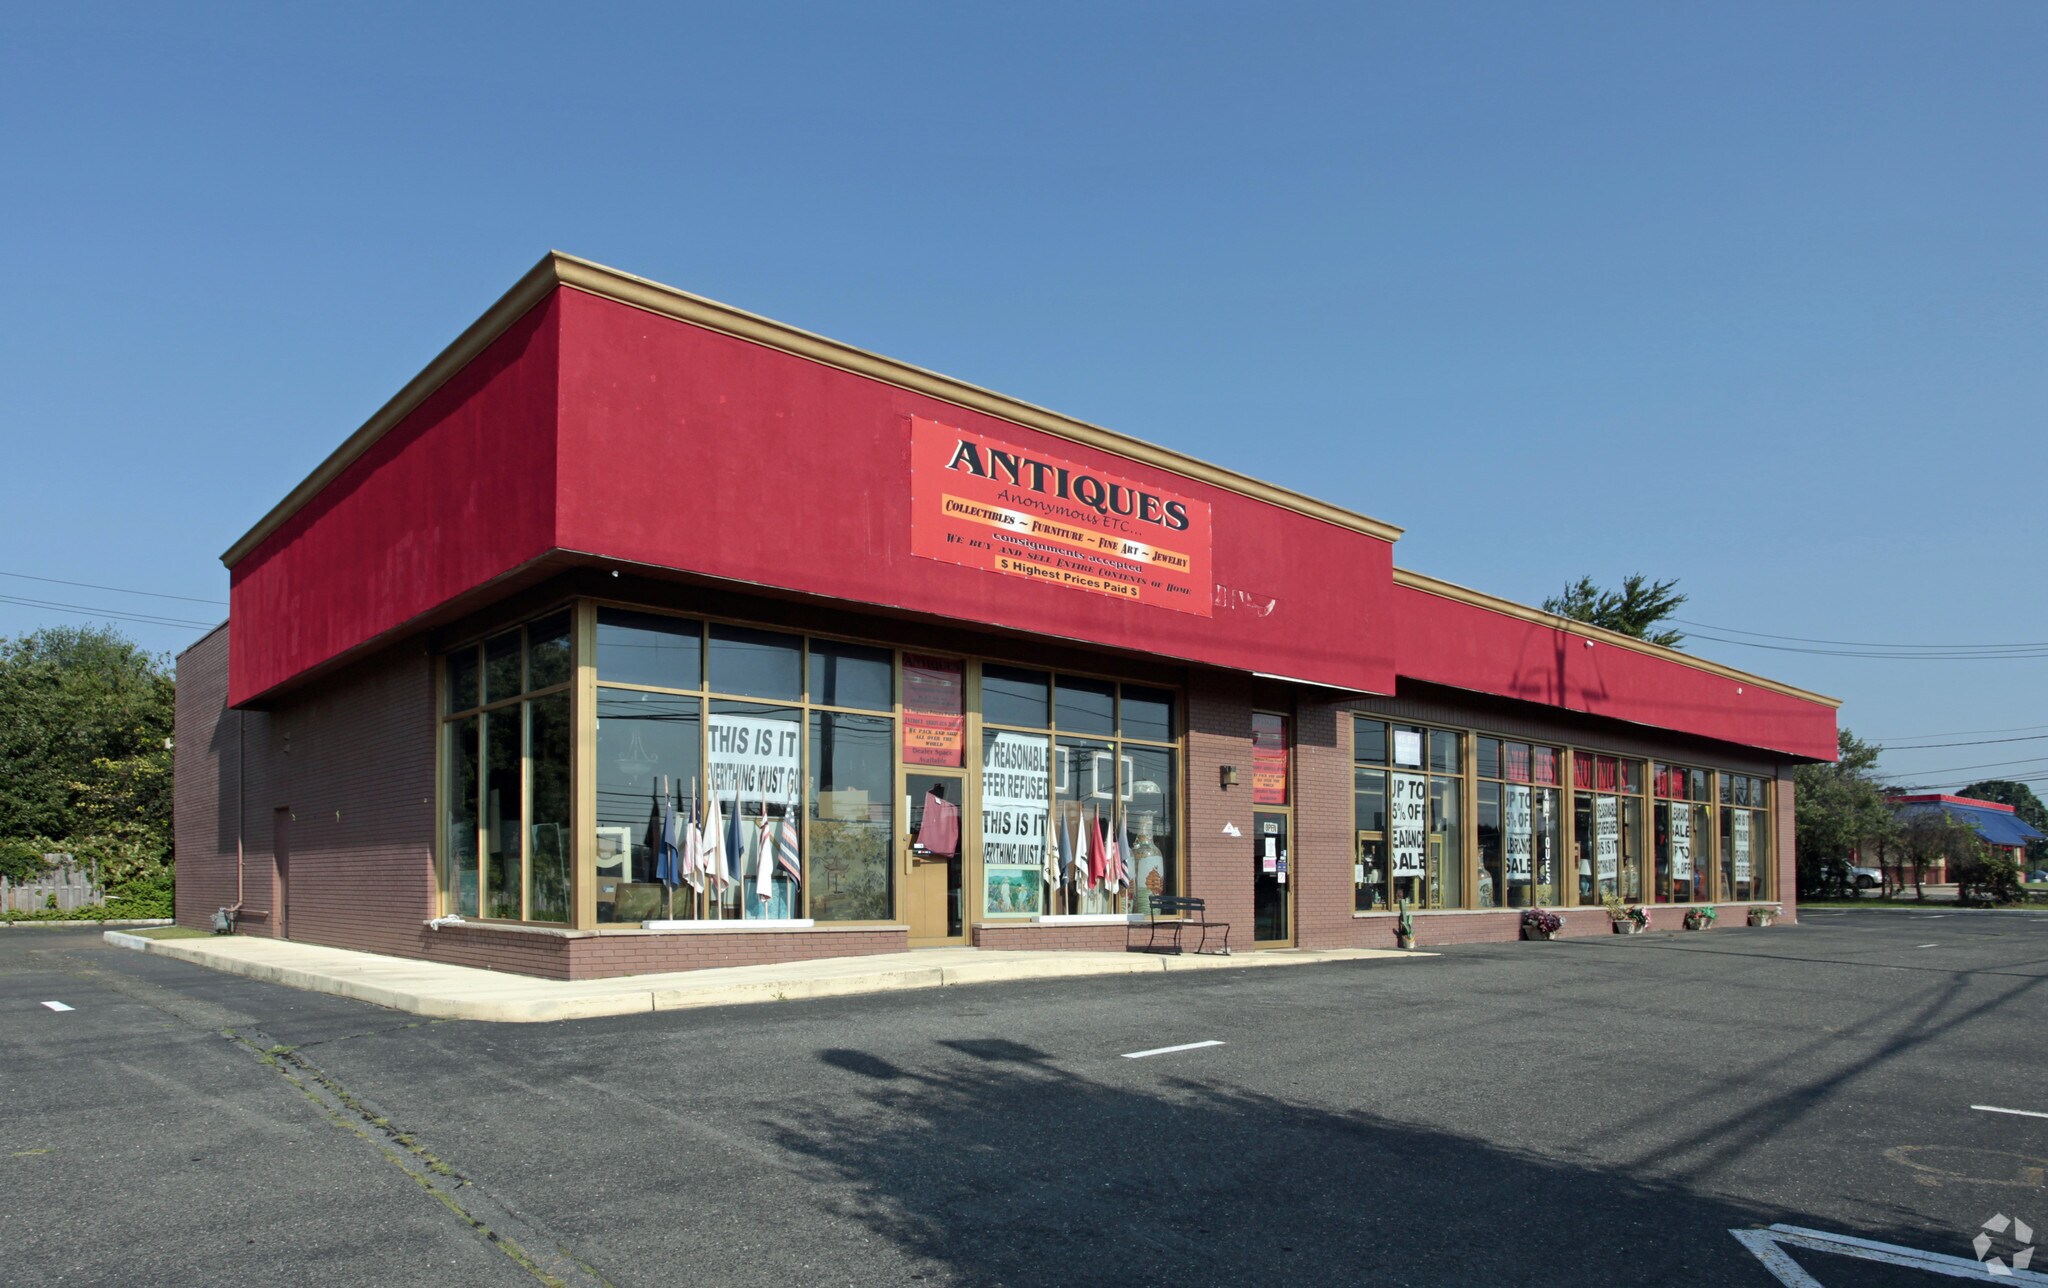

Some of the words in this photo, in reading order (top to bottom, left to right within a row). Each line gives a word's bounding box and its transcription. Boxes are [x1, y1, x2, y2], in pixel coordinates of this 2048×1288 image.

[945, 439, 1189, 531] ANTIQUES
[998, 489, 1099, 525] Anonymous
[1103, 515, 1142, 536] ETC...
[946, 499, 1015, 525] COLLECTIBLES
[1031, 520, 1084, 542] FURNITURE
[1152, 551, 1188, 568] JEWELRY
[992, 532, 1085, 560] consignments
[1088, 554, 1142, 574] accepted
[998, 546, 1022, 557] AND
[1026, 552, 1052, 564] SELL
[1001, 559, 1009, 569] $
[1013, 561, 1060, 580] Highest
[1064, 572, 1100, 588] Prices
[1103, 581, 1128, 595] Paid
[1130, 586, 1138, 597] $
[708, 725, 750, 754] THIS
[755, 728, 773, 756] IS
[779, 731, 797, 757] IT
[708, 763, 755, 792] VERYTHING
[757, 765, 785, 794] MUST
[1008, 775, 1049, 800] REFUSED
[983, 811, 1012, 834] THIS
[1016, 813, 1028, 836] IS
[1034, 814, 1047, 837] IT
[1672, 823, 1690, 839] ALE
[1018, 844, 1038, 864] MUST
